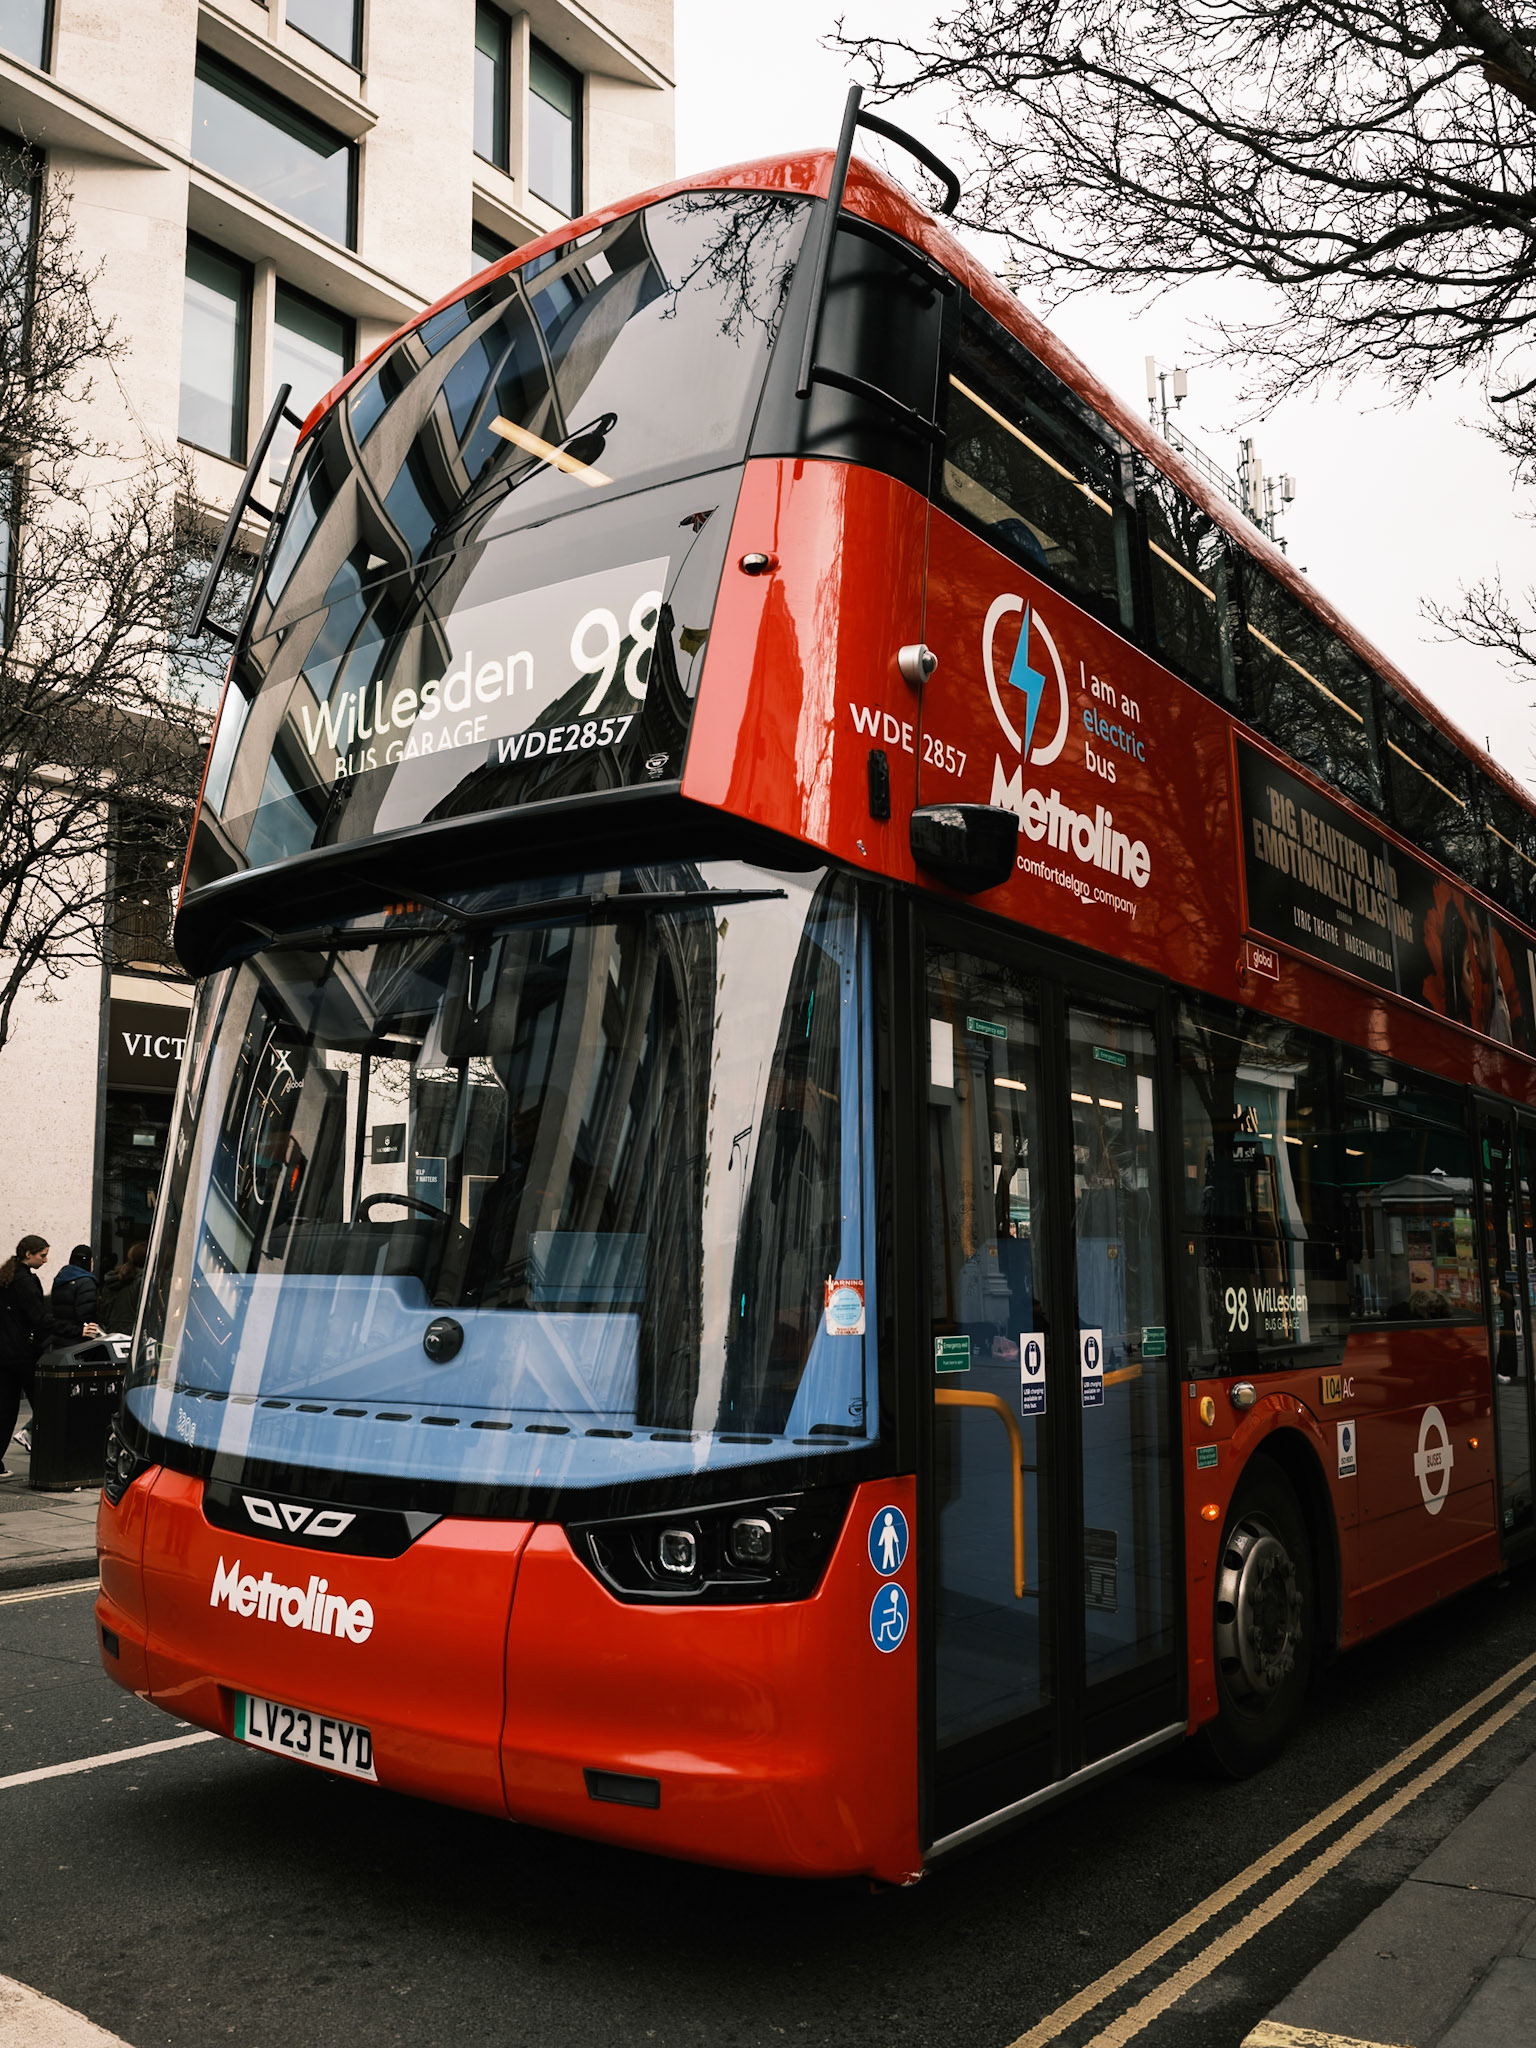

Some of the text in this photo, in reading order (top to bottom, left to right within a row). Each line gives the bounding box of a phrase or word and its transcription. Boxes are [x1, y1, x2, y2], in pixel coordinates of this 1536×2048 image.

[301, 590, 663, 756] Willesden 98
[1080, 660, 1140, 723] I am an
[335, 714, 488, 780] BUS GARAGE
[497, 715, 634, 764] WDE2857
[850, 702, 967, 778] WDE 2857
[1083, 707, 1146, 762] electric
[1085, 740, 1117, 783] bus
[990, 753, 1151, 888] Metroline
[1252, 817, 1352, 910] EMOTIONALLY
[1301, 807, 1373, 885] BEAUTIFUL
[1373, 855, 1399, 900] AND
[1017, 855, 1137, 920] comfortdelgro company
[1294, 905, 1311, 932] LYRIC
[1313, 916, 1339, 946] THEATRE
[1253, 948, 1273, 968] global
[1225, 1287, 1308, 1332] 98 Willesden
[1265, 1318, 1276, 1330] BUS
[1325, 1376, 1355, 1400] 104 AC
[1426, 1452, 1442, 1468] BUSES
[210, 1555, 374, 1644] Metroline
[249, 1697, 373, 1771] LV23 EYD
